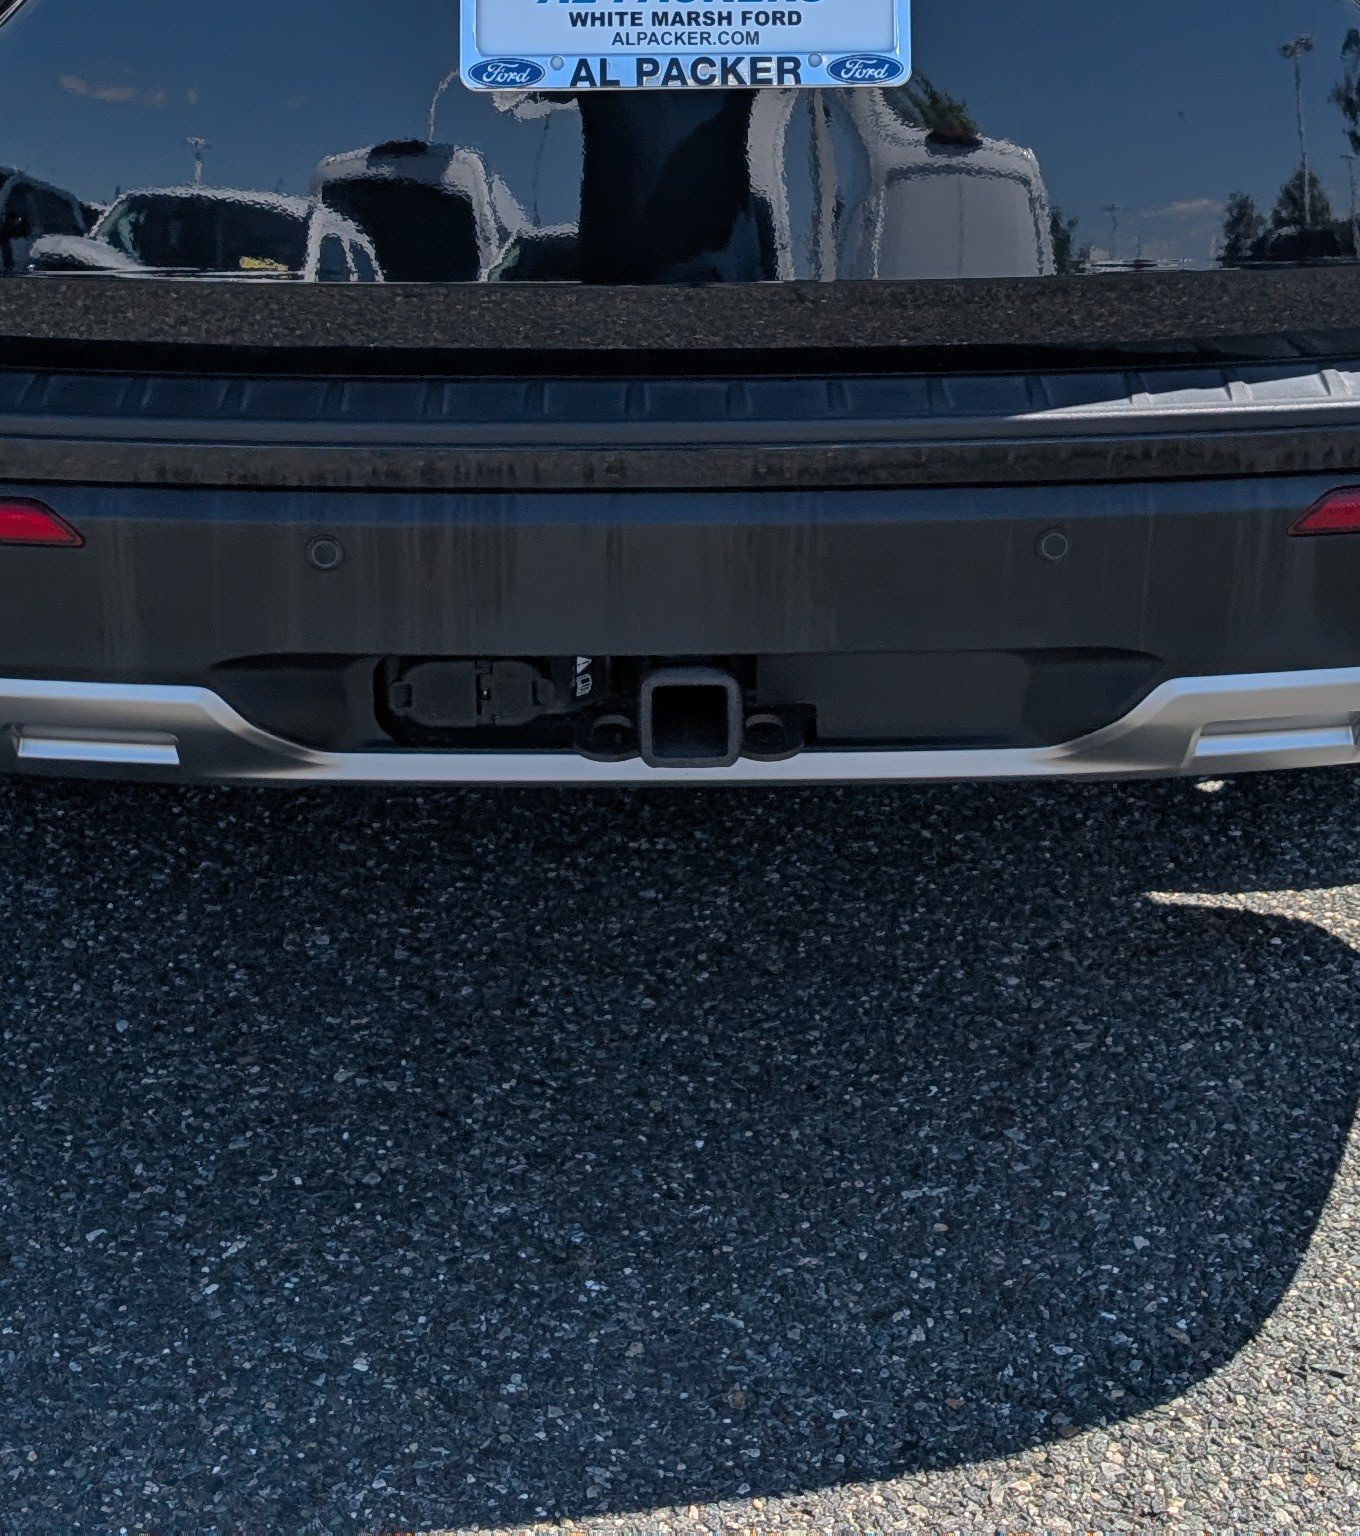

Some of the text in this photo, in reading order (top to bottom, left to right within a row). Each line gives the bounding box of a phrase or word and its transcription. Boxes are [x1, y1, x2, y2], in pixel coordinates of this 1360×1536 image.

[568, 10, 802, 28] WHITE MARSH FORD
[611, 30, 761, 47] ALPACKER.COM
[570, 56, 802, 88] AL PACKER
